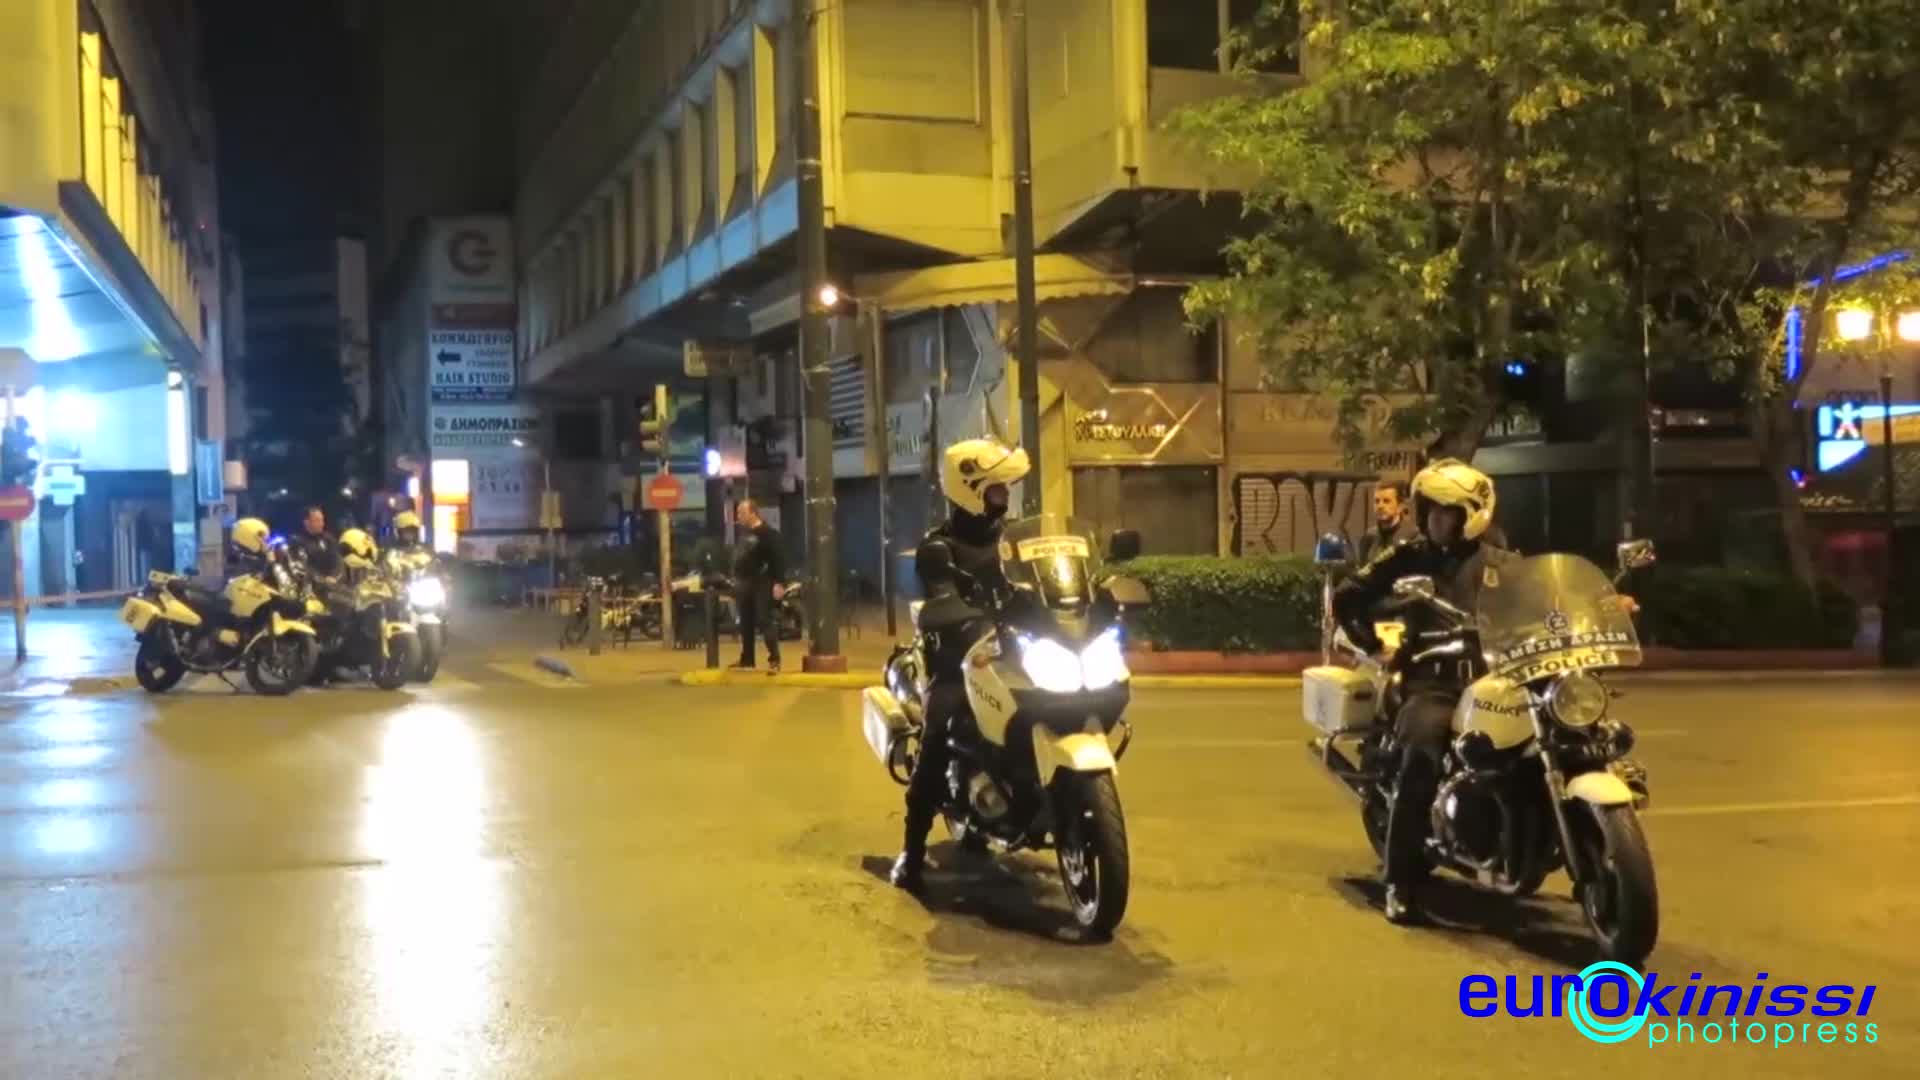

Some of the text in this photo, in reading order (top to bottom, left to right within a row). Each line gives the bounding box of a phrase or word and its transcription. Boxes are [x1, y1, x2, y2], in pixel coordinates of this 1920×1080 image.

[468, 371, 512, 384] STUDIO
[1528, 652, 1619, 676] POLICE
[1473, 698, 1521, 717] SUZUKI
